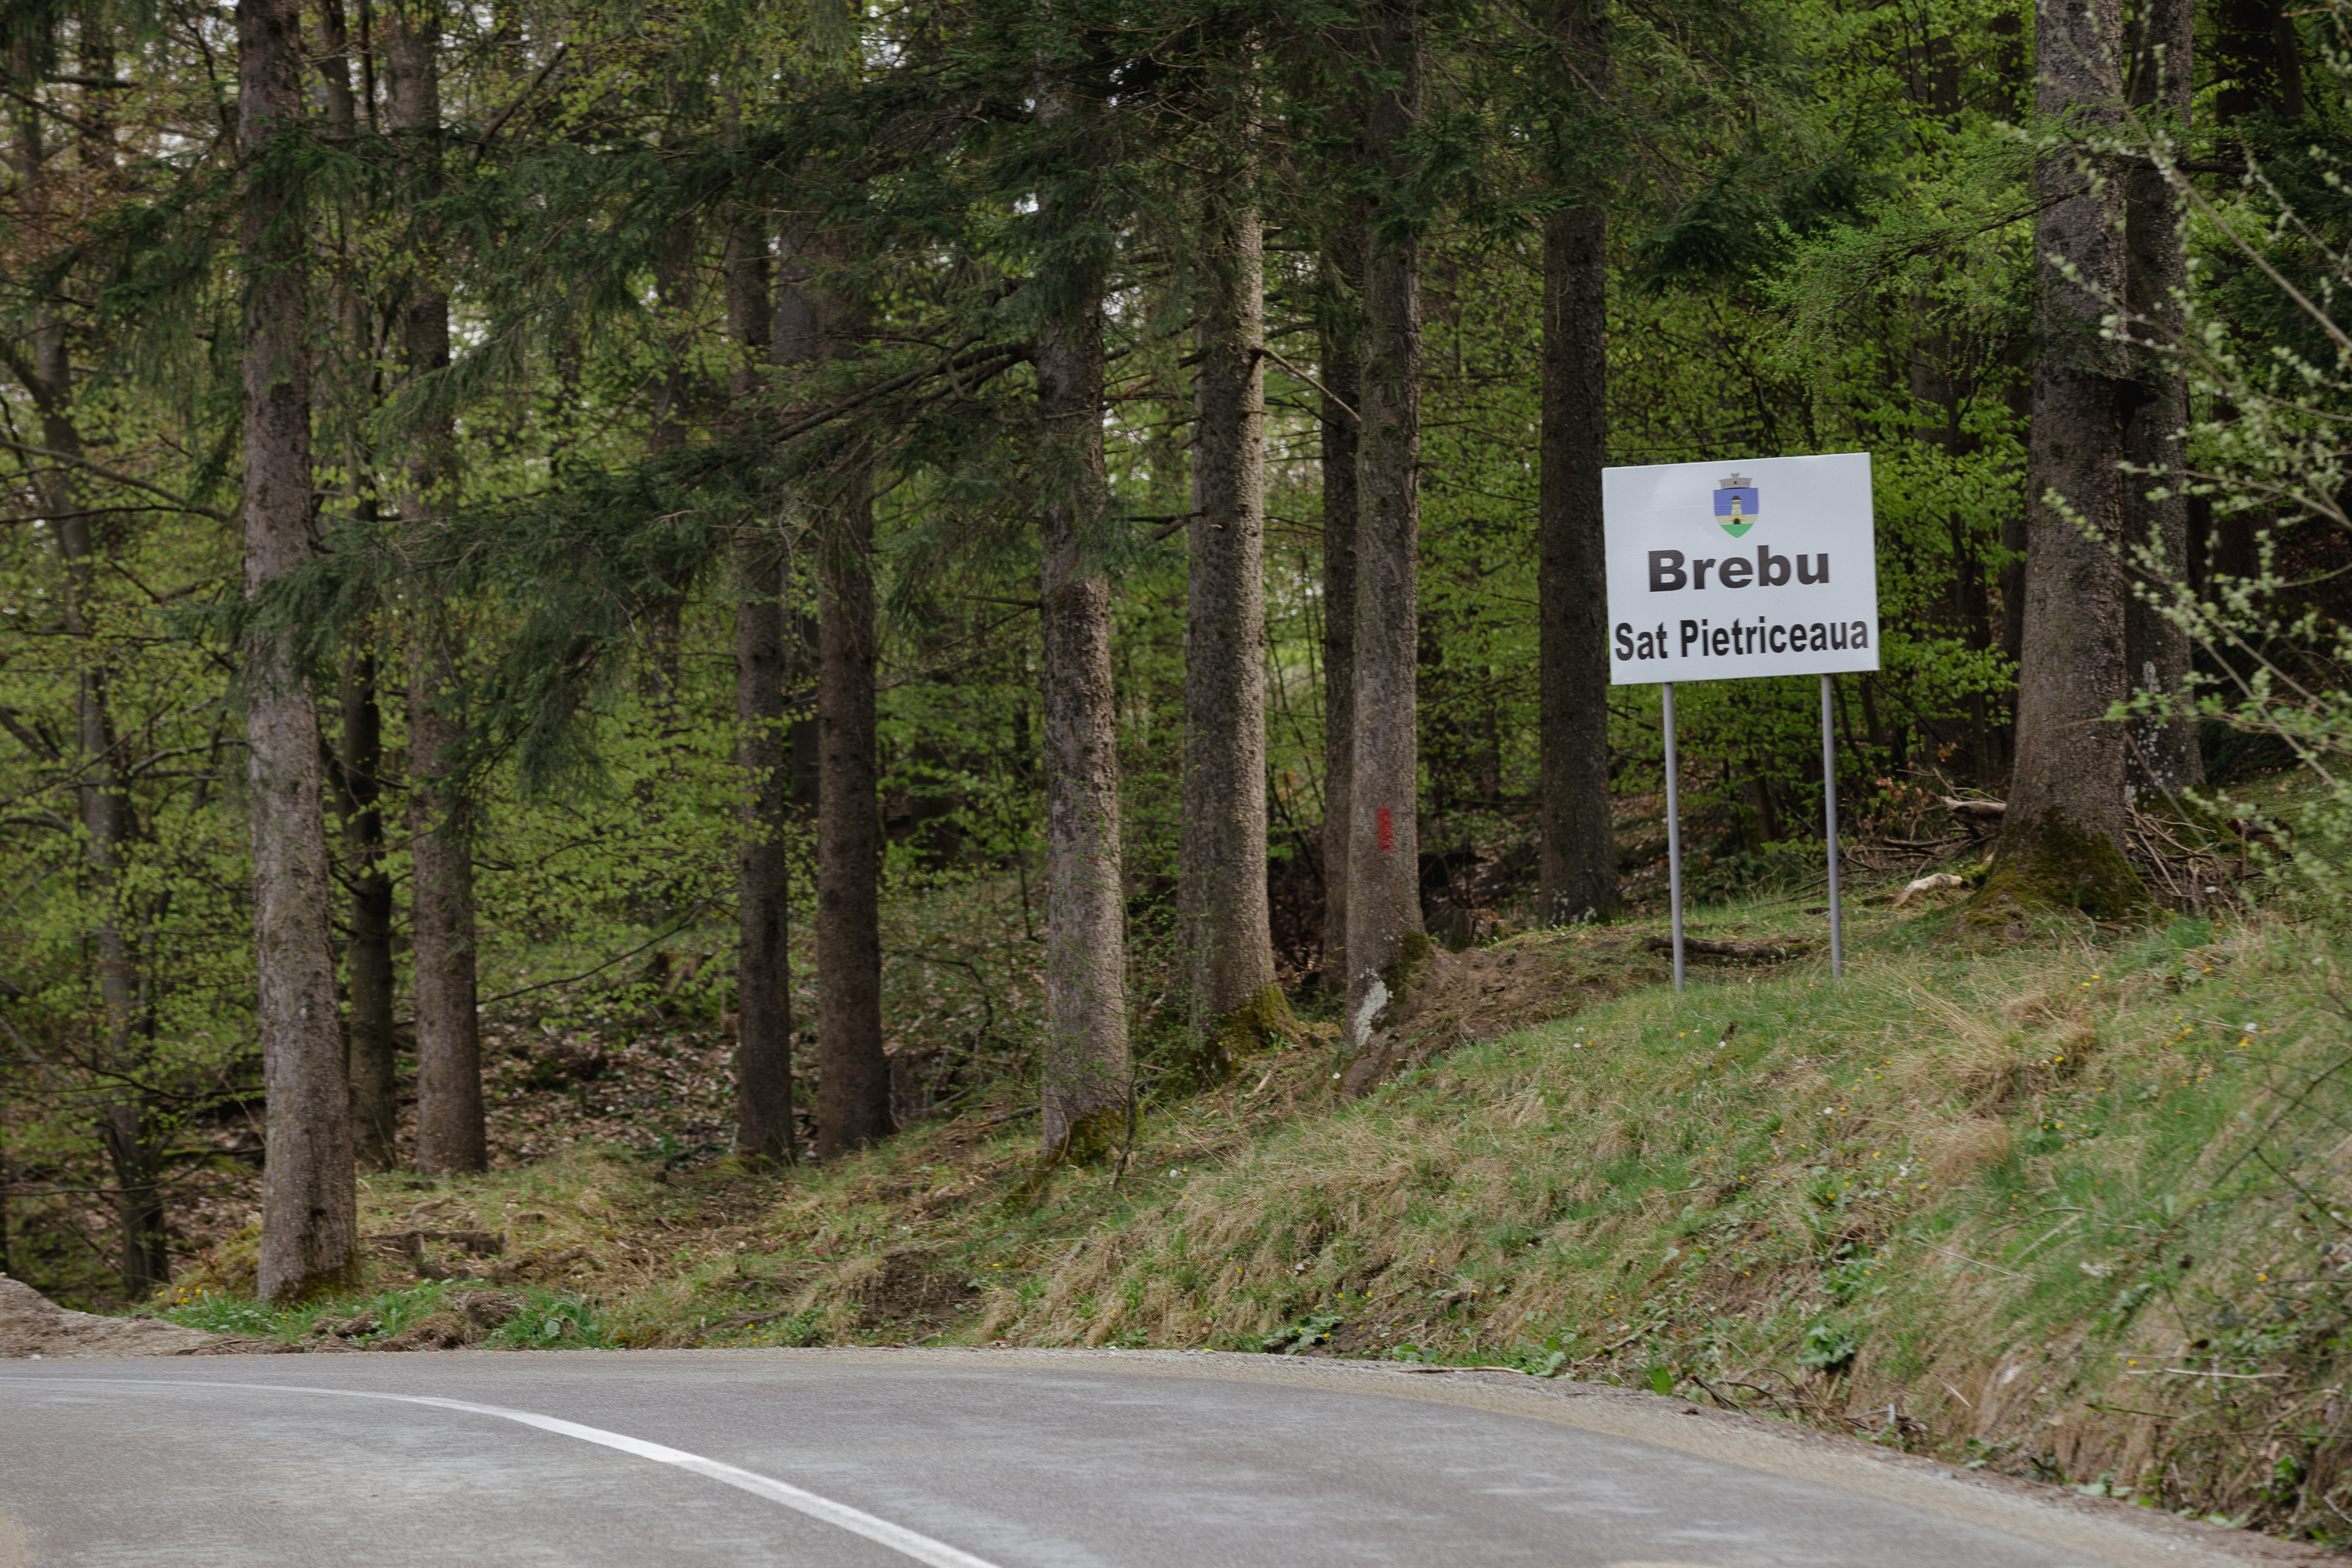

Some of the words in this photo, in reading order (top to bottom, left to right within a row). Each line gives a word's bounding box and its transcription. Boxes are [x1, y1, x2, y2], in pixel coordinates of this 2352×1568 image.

[1648, 545, 1829, 593] Brebu
[1615, 622, 1668, 661] Sat
[1679, 615, 1869, 657] Pietriceaua
